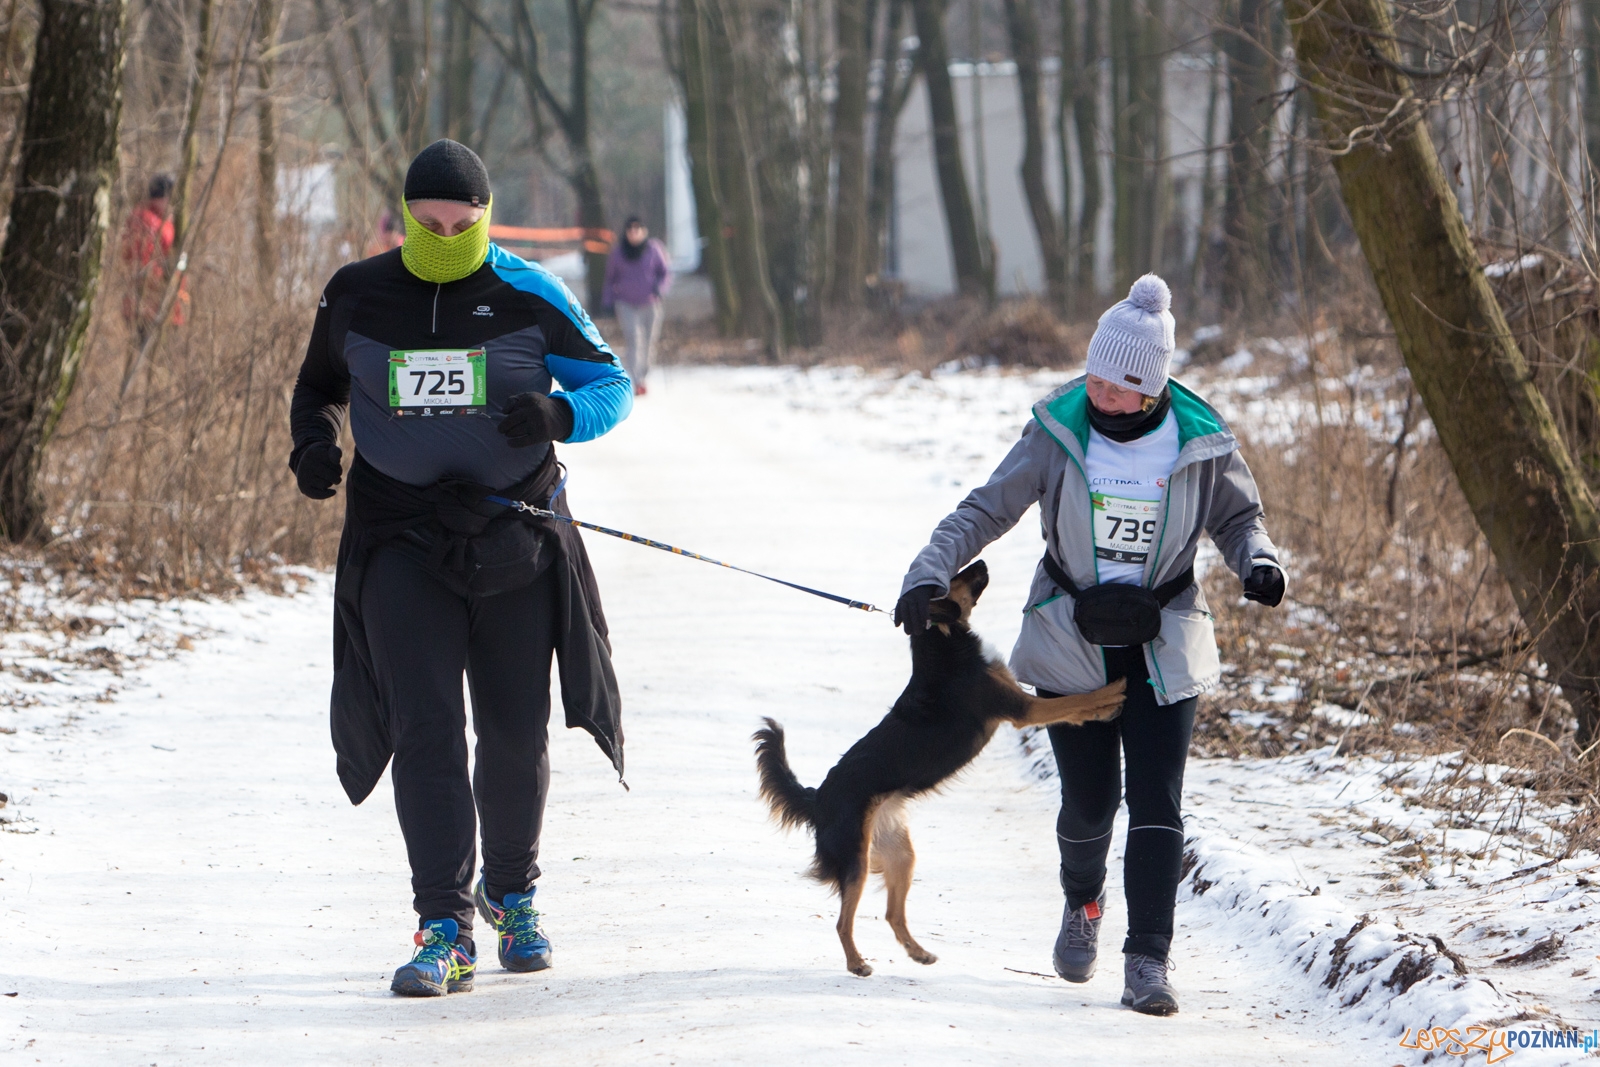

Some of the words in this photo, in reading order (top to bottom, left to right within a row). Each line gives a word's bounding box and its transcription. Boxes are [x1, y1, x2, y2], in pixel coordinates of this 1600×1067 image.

[409, 370, 465, 396] 725
[1106, 515, 1157, 544] 739
[1110, 542, 1151, 552] MAGDALENA
